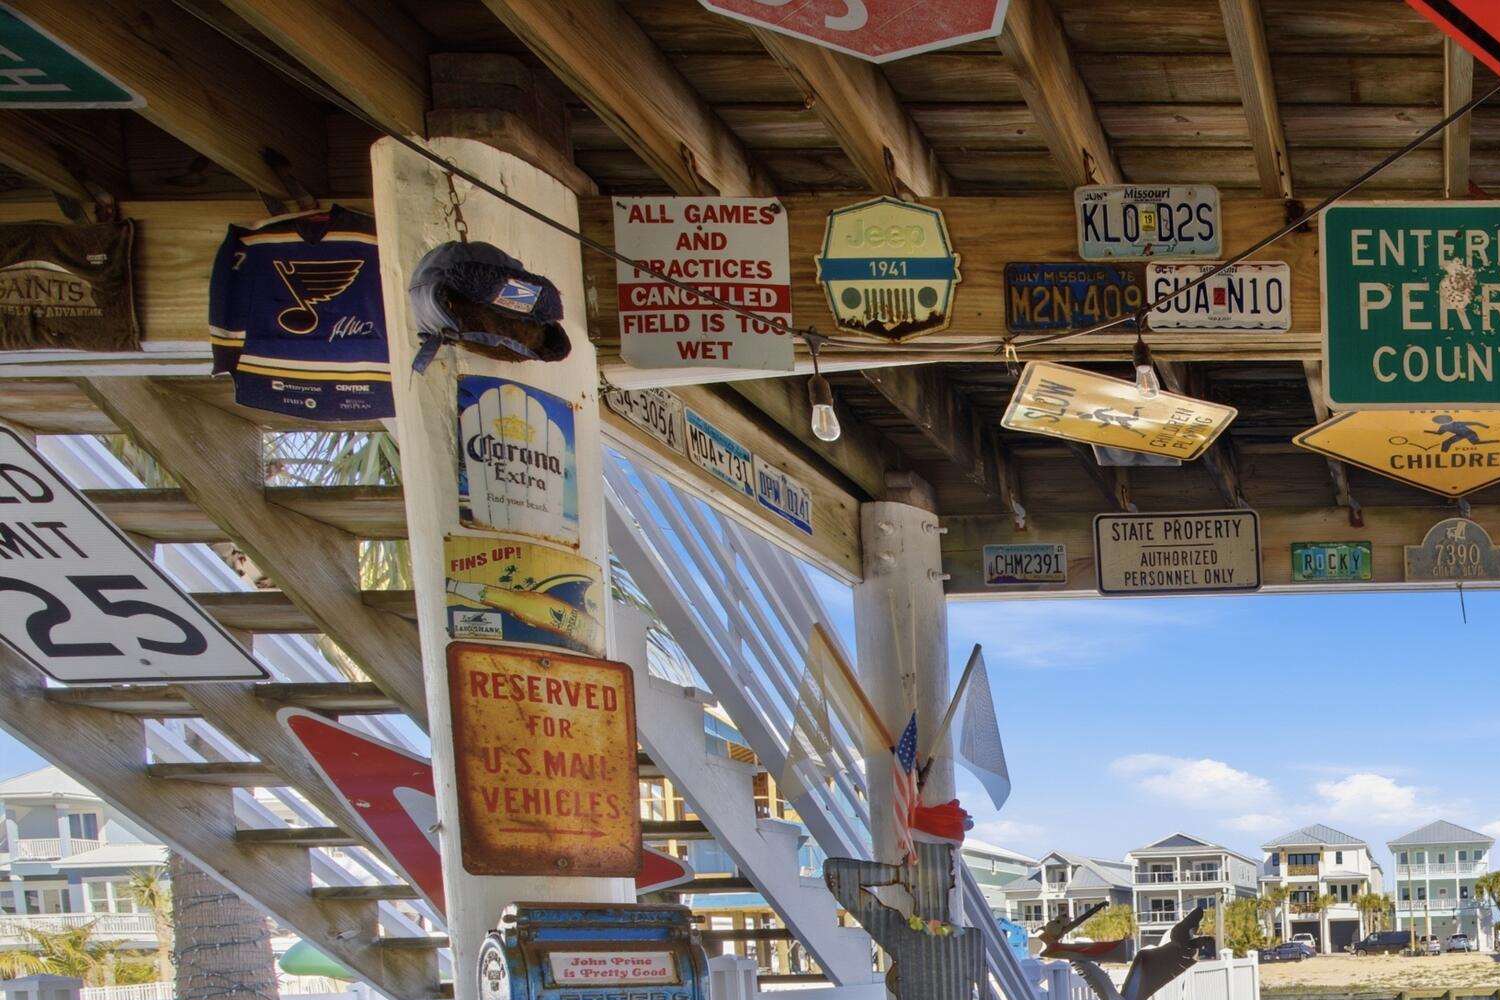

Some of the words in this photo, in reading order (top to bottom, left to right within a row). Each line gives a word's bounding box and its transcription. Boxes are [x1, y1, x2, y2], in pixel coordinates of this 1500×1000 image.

[1124, 188, 1170, 198] Missouri
[628, 205, 674, 225] ALL
[684, 206, 777, 225] GAMES
[1144, 215, 1152, 224] 19
[1157, 203, 1213, 242] D2S
[676, 232, 728, 251] AND
[846, 219, 925, 249] Jeep
[633, 260, 773, 279] PRACTICES
[868, 261, 908, 278] 1941
[631, 287, 778, 308] CANCELLED
[624, 314, 690, 334] FIELD
[701, 314, 725, 333] IS
[740, 314, 788, 336] TOO
[677, 341, 733, 360] WET
[467, 433, 562, 478] Corona
[495, 462, 546, 491] Extra
[486, 493, 505, 503] Find
[507, 497, 525, 509] your
[1112, 521, 1155, 541] STATE
[1163, 519, 1241, 540] PROPERTY
[451, 553, 487, 572] FINS
[492, 546, 522, 561] UP!
[995, 553, 1062, 575] CHM2391
[1140, 550, 1219, 566] AUTHORIZED
[1304, 553, 1360, 571] ROCKY
[1435, 543, 1480, 566] 7390
[1124, 570, 1198, 587] PERSONNEL
[1204, 568, 1235, 584] ONLY
[0, 574, 208, 658] 25
[470, 671, 617, 712] RESERVED
[528, 715, 574, 739] FOR
[544, 750, 612, 783] MAIL
[481, 786, 620, 819] VEHICLES
[570, 957, 607, 967] John
[610, 957, 653, 967] Prine
[563, 968, 575, 978] is
[579, 967, 628, 980] Pretty
[632, 967, 667, 978] Good
